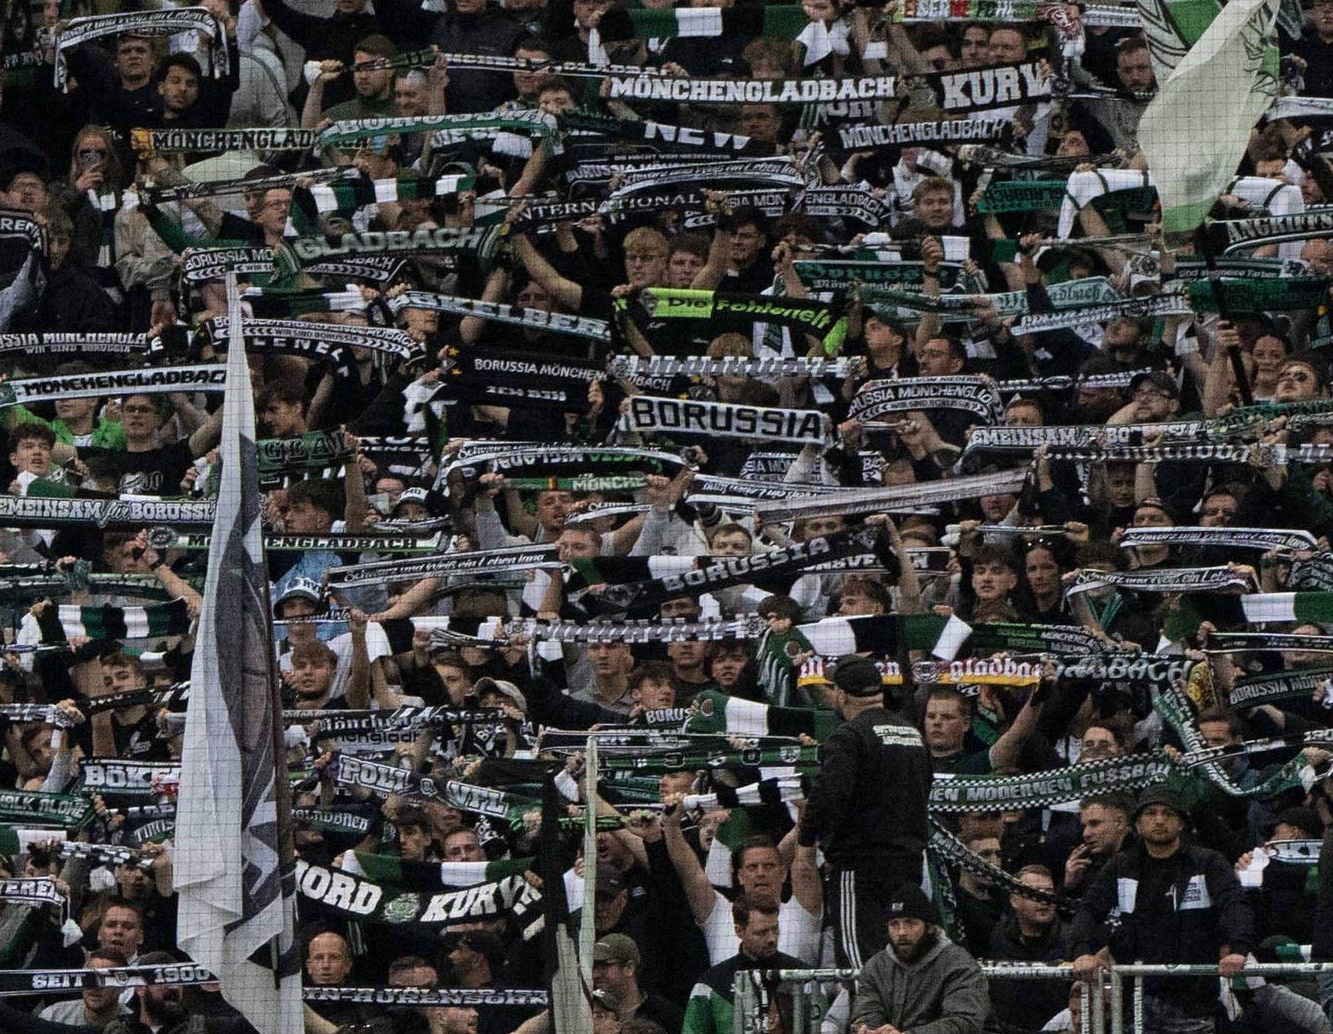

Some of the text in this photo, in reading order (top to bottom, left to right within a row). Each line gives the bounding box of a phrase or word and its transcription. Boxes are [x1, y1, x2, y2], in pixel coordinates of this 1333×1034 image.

[609, 77, 895, 102] MÖNCHENGLADBACH
[474, 359, 537, 374] BORUSSIA
[635, 400, 821, 442] BORUSSIA
[663, 537, 829, 591] BORUSSIA
[32, 967, 209, 989] SEIT 1900
